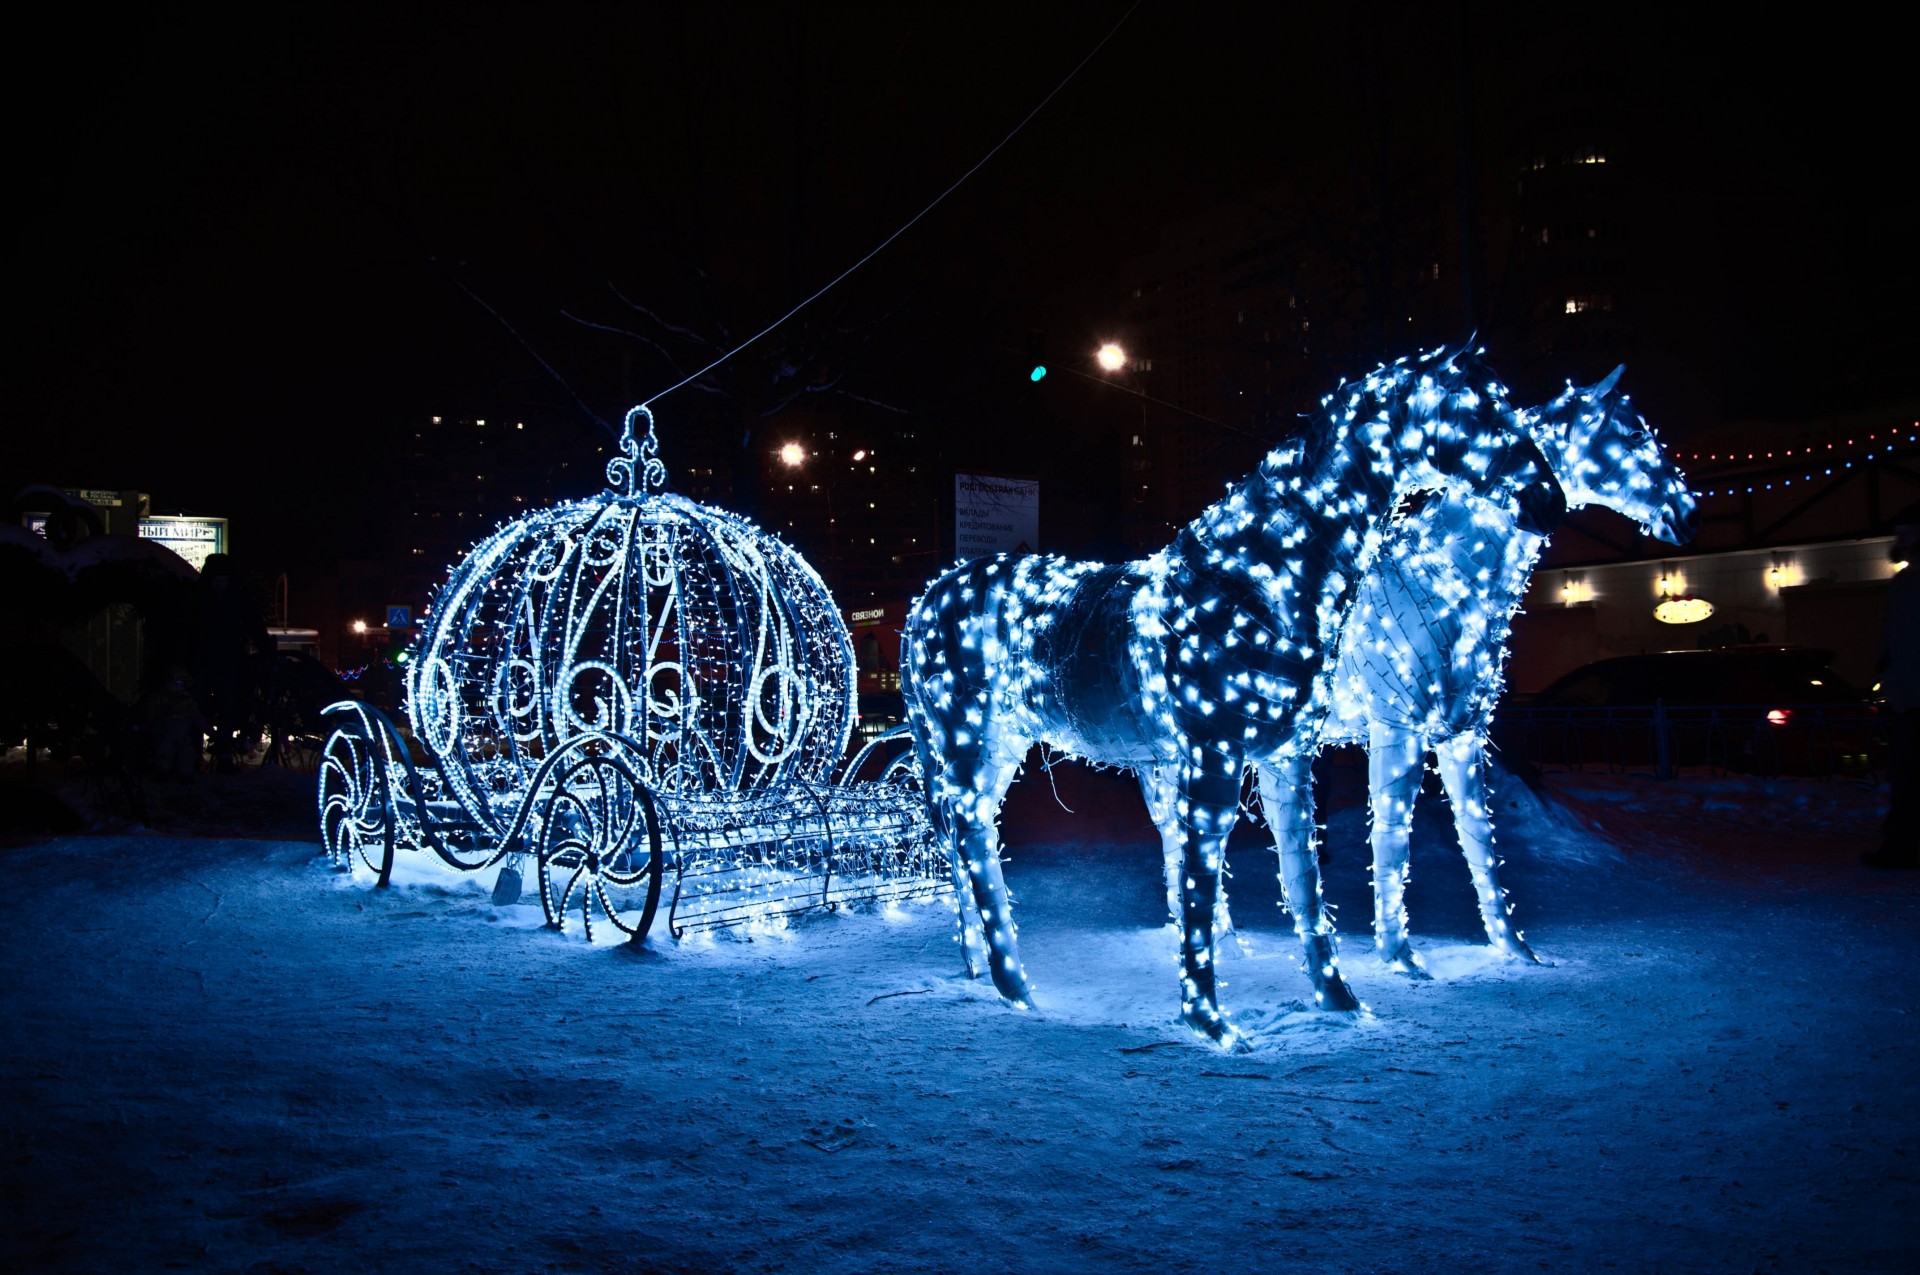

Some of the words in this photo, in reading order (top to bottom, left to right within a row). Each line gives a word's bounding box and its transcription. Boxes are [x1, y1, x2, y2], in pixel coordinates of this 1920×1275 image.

[960, 508, 989, 518] ВКЛАДЫ
[960, 521, 1014, 532] КРЕДИТОВАНИЕ
[173, 527, 202, 538] МИР
[960, 534, 997, 545] ПЕРЕВОДЫ
